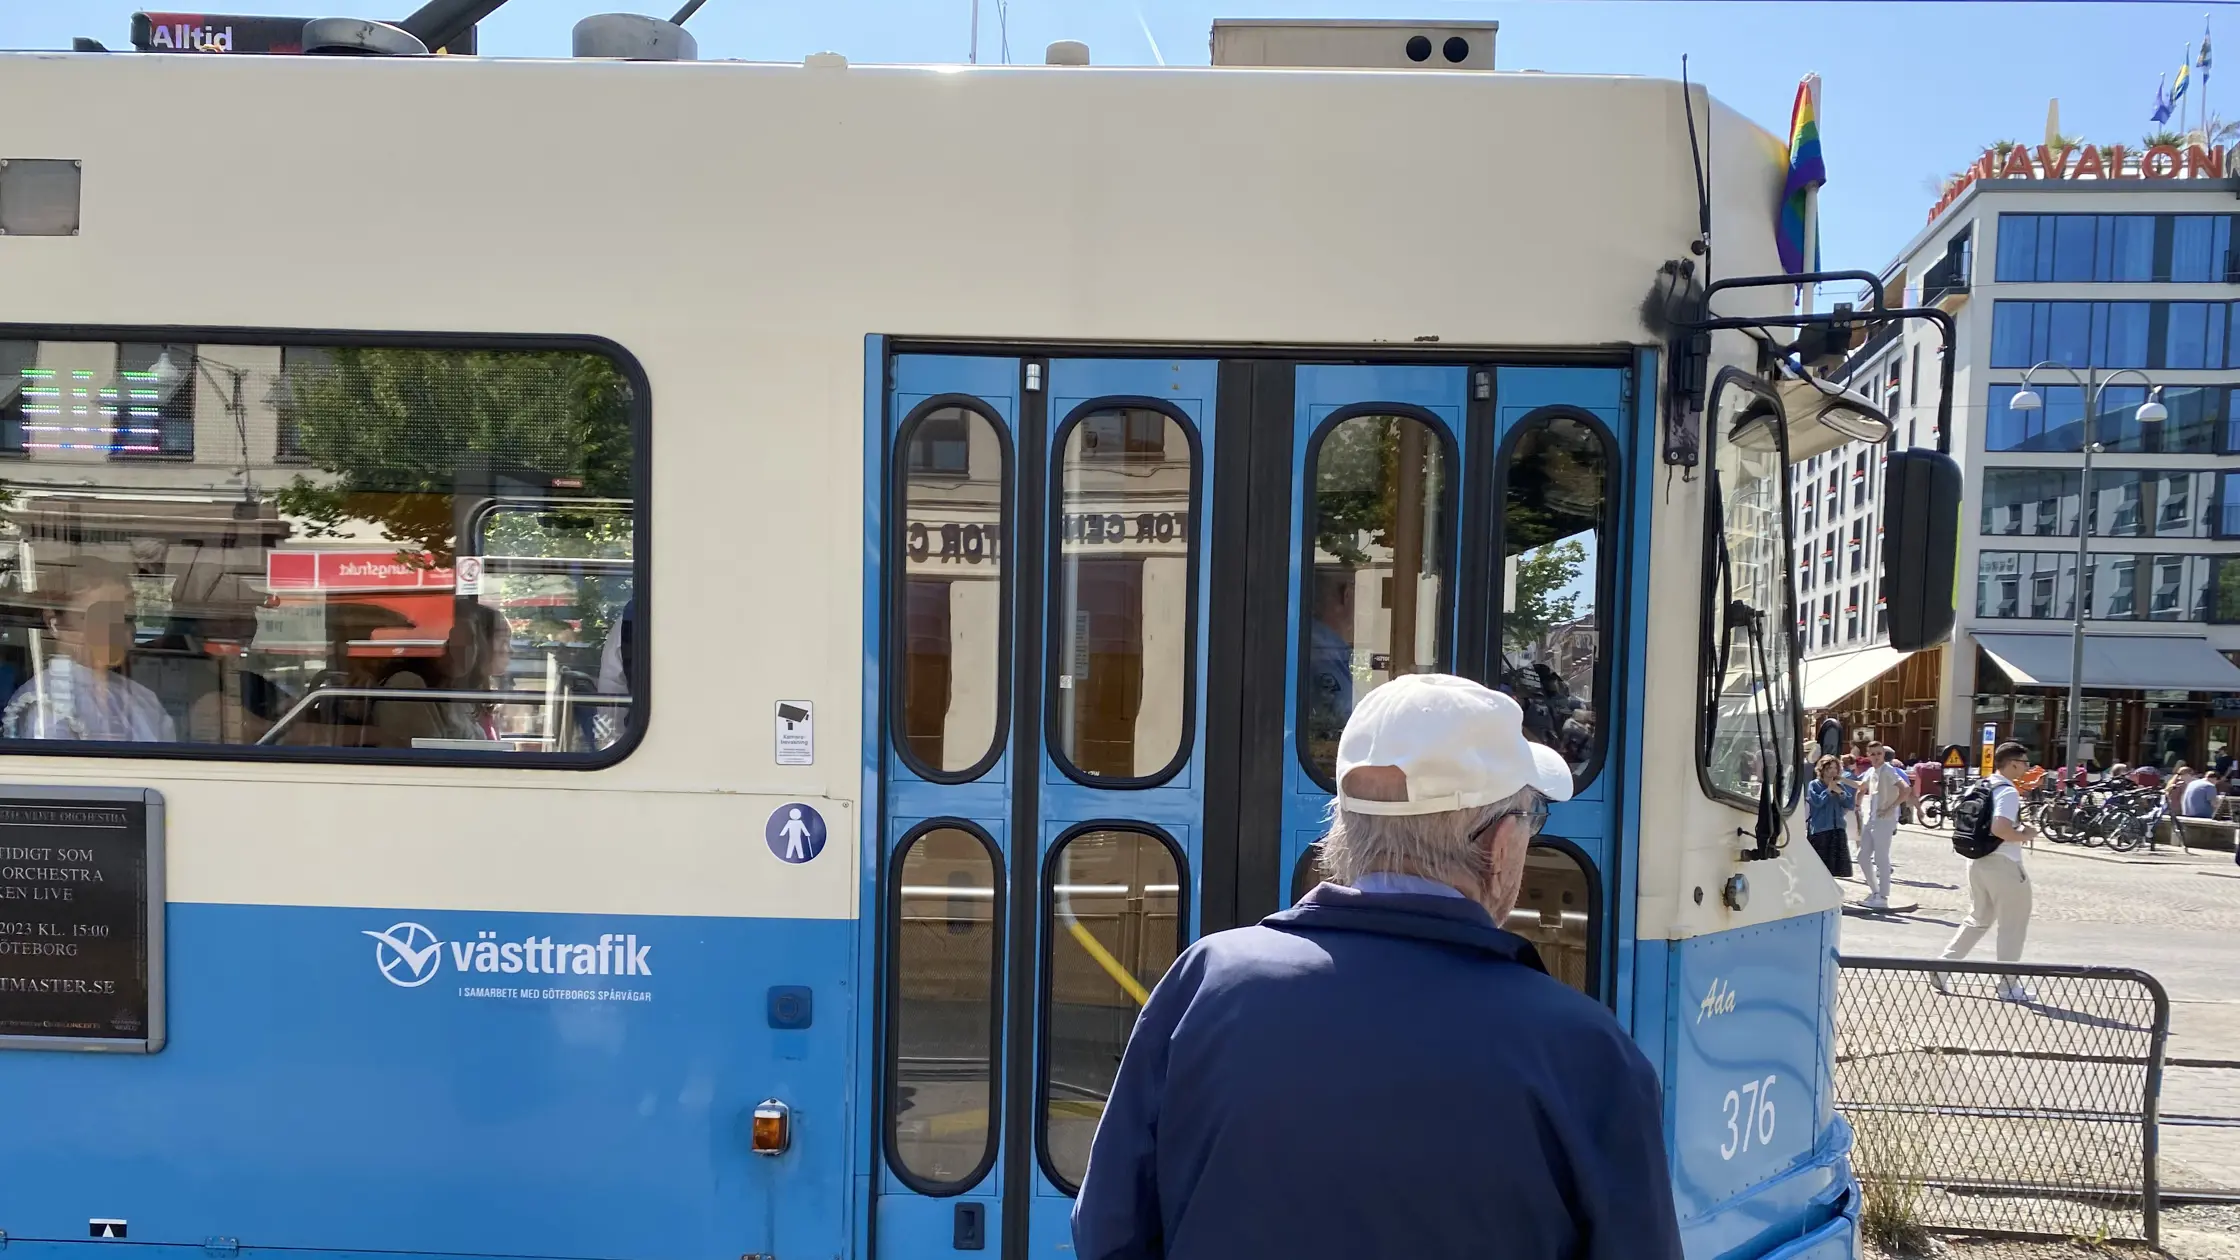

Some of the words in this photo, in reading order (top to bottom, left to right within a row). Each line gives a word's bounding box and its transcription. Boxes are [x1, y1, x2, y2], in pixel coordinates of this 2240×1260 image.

[153, 24, 233, 50] Alltid
[1999, 144, 2225, 180] AVALON
[57, 848, 94, 862] SOM
[2, 866, 104, 882] ORCHESTRA
[33, 887, 73, 901] LIVE
[0, 922, 32, 936] 2023
[38, 923, 65, 936] KL.
[73, 924, 109, 937] 15:00
[0, 938, 78, 956] ÖTEBORG
[451, 931, 652, 976] västtrafik
[0, 977, 115, 994] TMASTER.SE
[458, 987, 462, 997] I
[464, 987, 518, 998] SAMARBETE
[520, 988, 540, 999] MED
[542, 987, 595, 1000] GÖTEBORGS
[597, 987, 652, 1001] SPÅRVÄGAR
[1696, 977, 1736, 1024] Ada
[1720, 1074, 1776, 1160] 376
